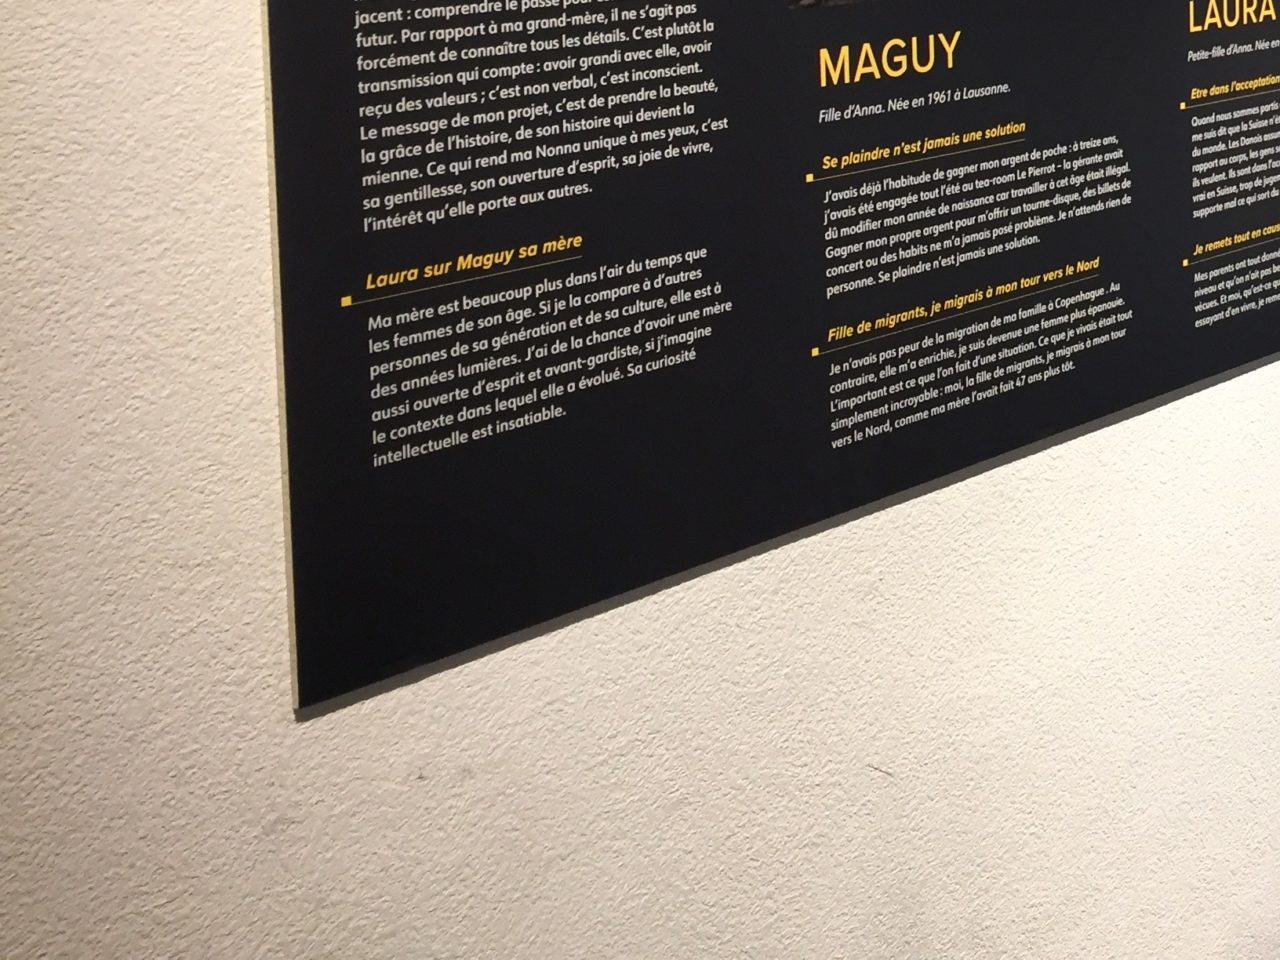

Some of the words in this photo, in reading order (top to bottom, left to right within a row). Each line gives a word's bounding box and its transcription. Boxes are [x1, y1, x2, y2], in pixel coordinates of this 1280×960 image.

[819, 30, 961, 87] MAGUY
[818, 106, 842, 123] Fille
[842, 103, 885, 119] d'Anna.
[886, 96, 910, 112] Née
[910, 96, 925, 108] en
[927, 88, 951, 105] 1961
[952, 87, 961, 101] à
[962, 83, 1011, 100] Lausanne.
[821, 155, 839, 169] Se
[840, 146, 890, 169] plaindre
[892, 139, 922, 156] n'est
[921, 132, 960, 154] jamais
[961, 130, 983, 143] une
[984, 121, 1026, 139] solution
[365, 267, 419, 290] Laura
[423, 261, 453, 278] sur
[456, 248, 515, 271] Maguy
[518, 244, 538, 259] sa
[541, 235, 583, 254] mère
[825, 276, 876, 300] personne.
[877, 270, 891, 283] Se
[891, 260, 931, 283] plaindre
[932, 254, 955, 269] n'est
[955, 246, 986, 267] jamais
[986, 243, 1004, 256] une
[1004, 234, 1040, 251] solution.
[1192, 243, 1204, 256] Je
[1204, 236, 1233, 252] remets
[1233, 230, 1251, 244] tout
[1250, 228, 1262, 239] en
[367, 314, 392, 331] Ma
[395, 306, 434, 325] mère
[437, 299, 460, 316] est
[462, 285, 532, 310] beaucoup
[535, 277, 563, 298] plus
[564, 271, 597, 288] dans
[599, 263, 624, 280] l'air
[625, 258, 643, 274] du
[644, 252, 683, 270] temps
[684, 247, 707, 264] que
[827, 324, 854, 342] Fille
[856, 319, 872, 334] de
[874, 305, 928, 329] migrants,
[929, 300, 942, 317] je
[943, 288, 984, 310] migrais
[985, 285, 993, 298] à
[994, 280, 1018, 296] mon
[1019, 274, 1041, 289] tour
[1042, 268, 1063, 282] vers
[1064, 263, 1075, 276] le
[1075, 255, 1100, 273] Nord
